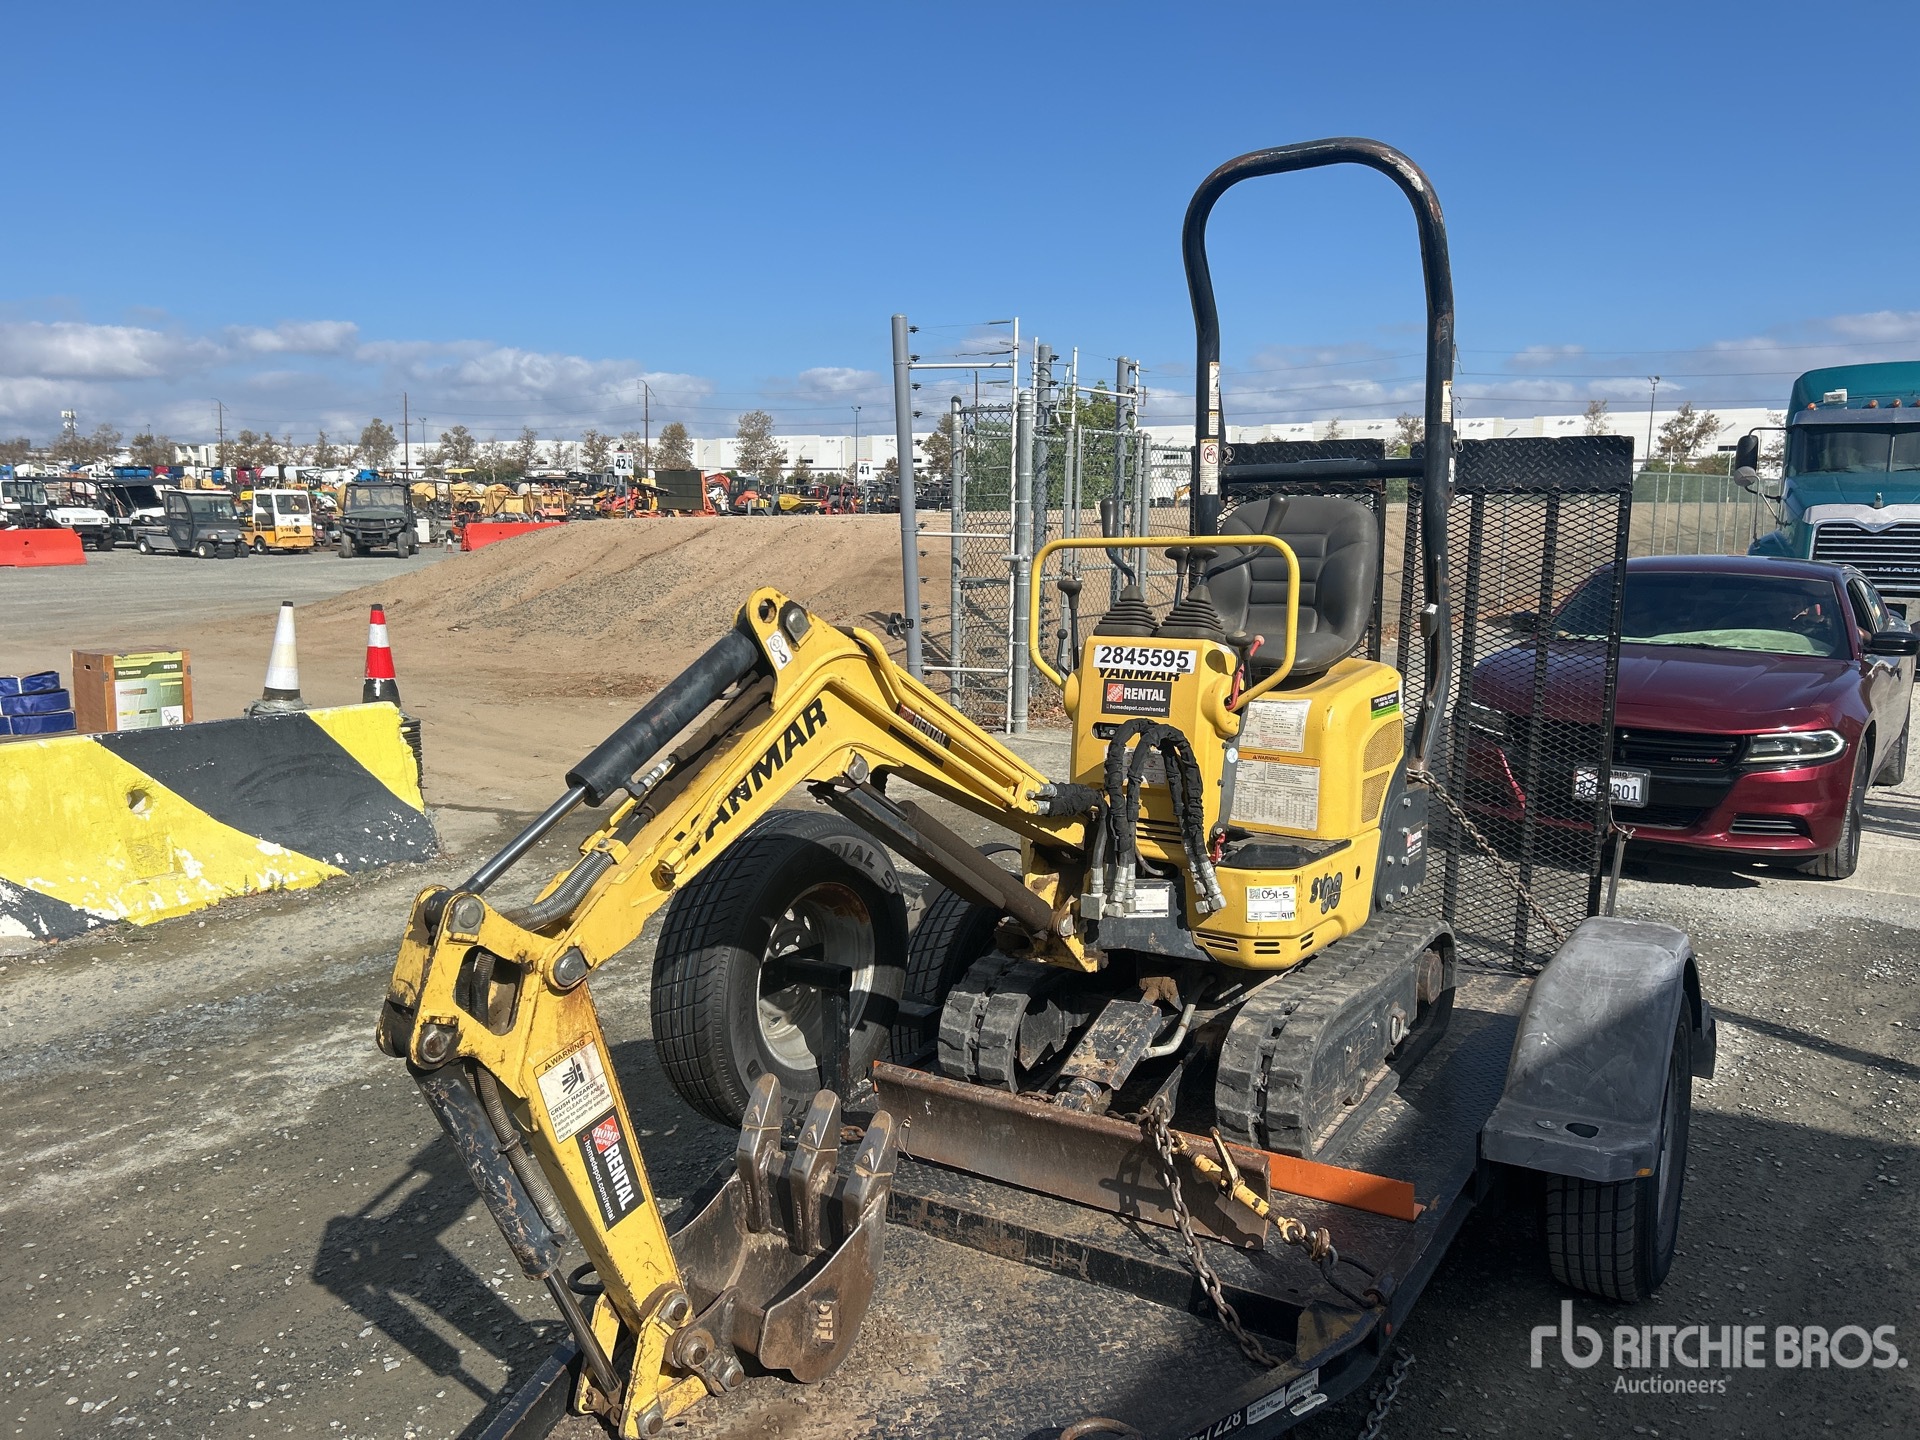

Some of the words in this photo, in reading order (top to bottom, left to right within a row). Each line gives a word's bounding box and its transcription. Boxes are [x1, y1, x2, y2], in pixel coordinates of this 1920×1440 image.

[616, 458, 626, 469] 42
[859, 466, 869, 475] 41
[1100, 646, 1190, 668] 2845595
[1099, 667, 1180, 681] YANMAR
[1123, 687, 1166, 701] RENTAL
[1109, 704, 1166, 713] homedepot.com/rental
[912, 713, 948, 747] RENTAL
[550, 1038, 586, 1067] WARNING
[551, 1099, 570, 1116] CRUSH
[552, 1109, 566, 1122] STAY
[566, 1097, 582, 1113] CLEAR
[554, 1113, 570, 1128] Failure
[576, 1098, 593, 1113] comply
[556, 1121, 570, 1134] result
[574, 1108, 588, 1121] death
[593, 1128, 619, 1140] HOME
[584, 1139, 615, 1221] homedepot.com/rental
[603, 1143, 635, 1211] RENTAL
